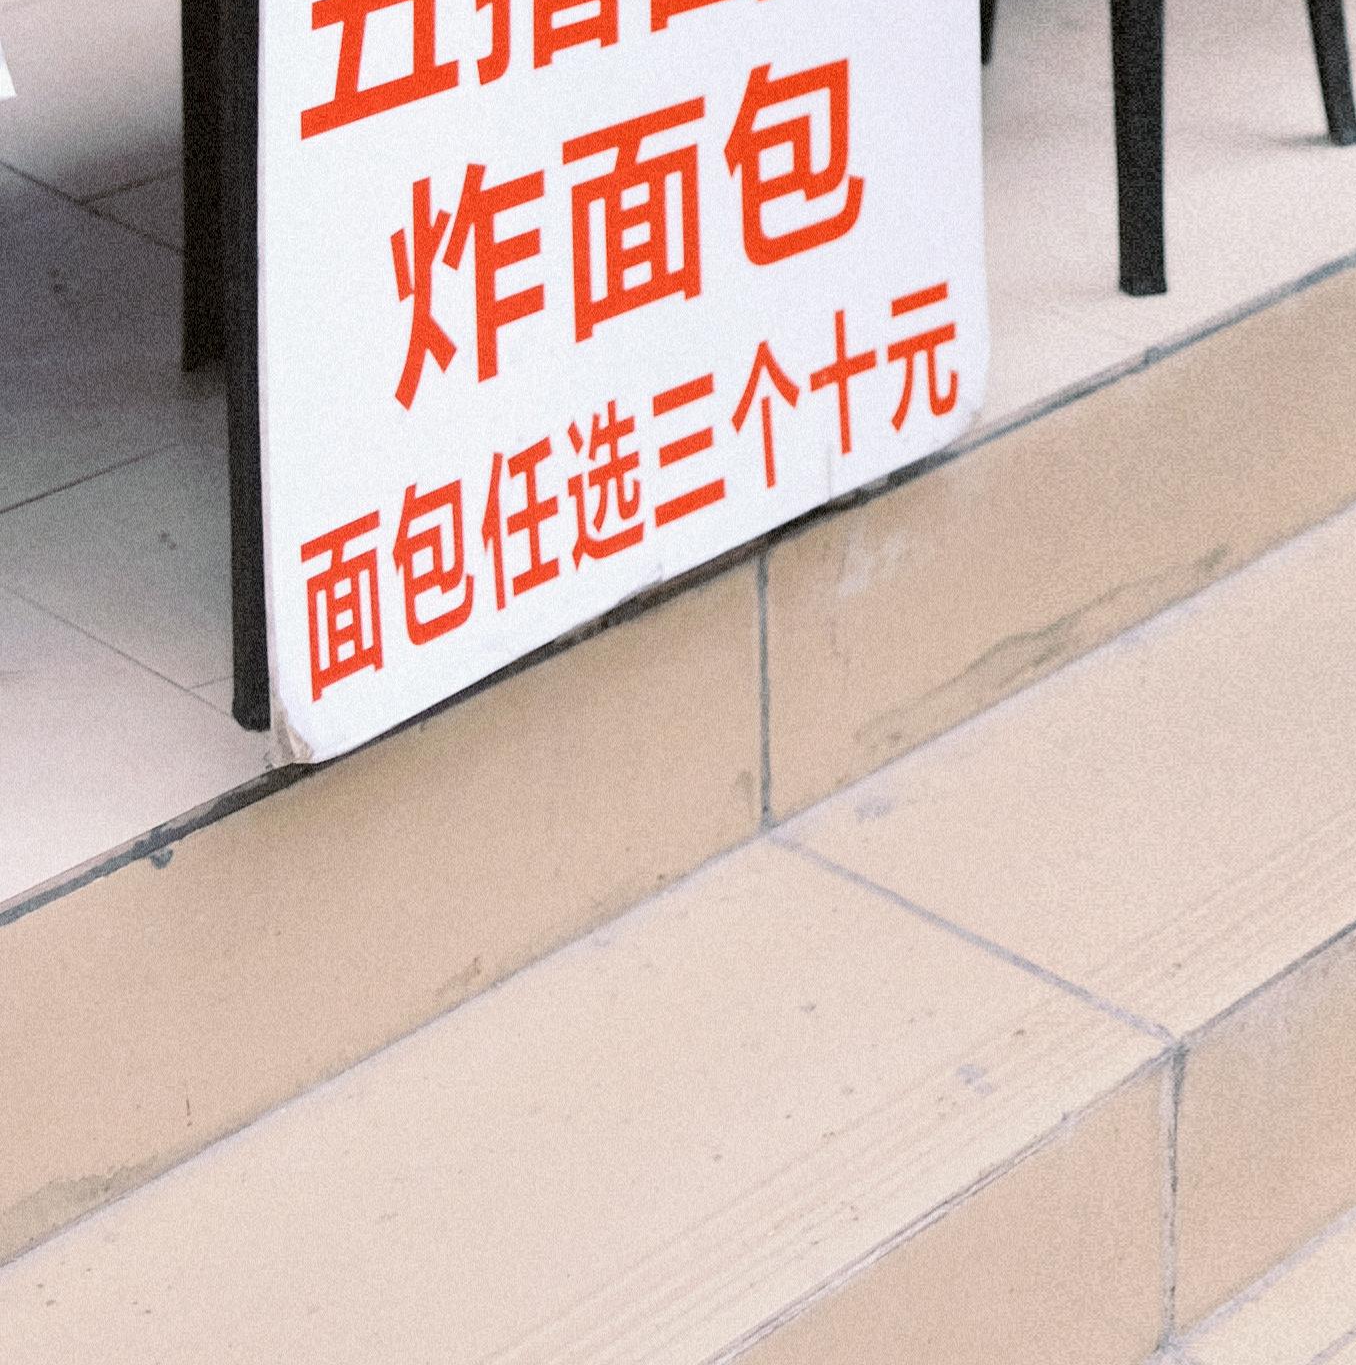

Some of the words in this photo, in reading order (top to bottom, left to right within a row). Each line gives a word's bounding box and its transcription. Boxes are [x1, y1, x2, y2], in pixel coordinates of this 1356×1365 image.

[390, 59, 865, 412] 炸面包
[300, 281, 960, 704] 面包任选三个十元
